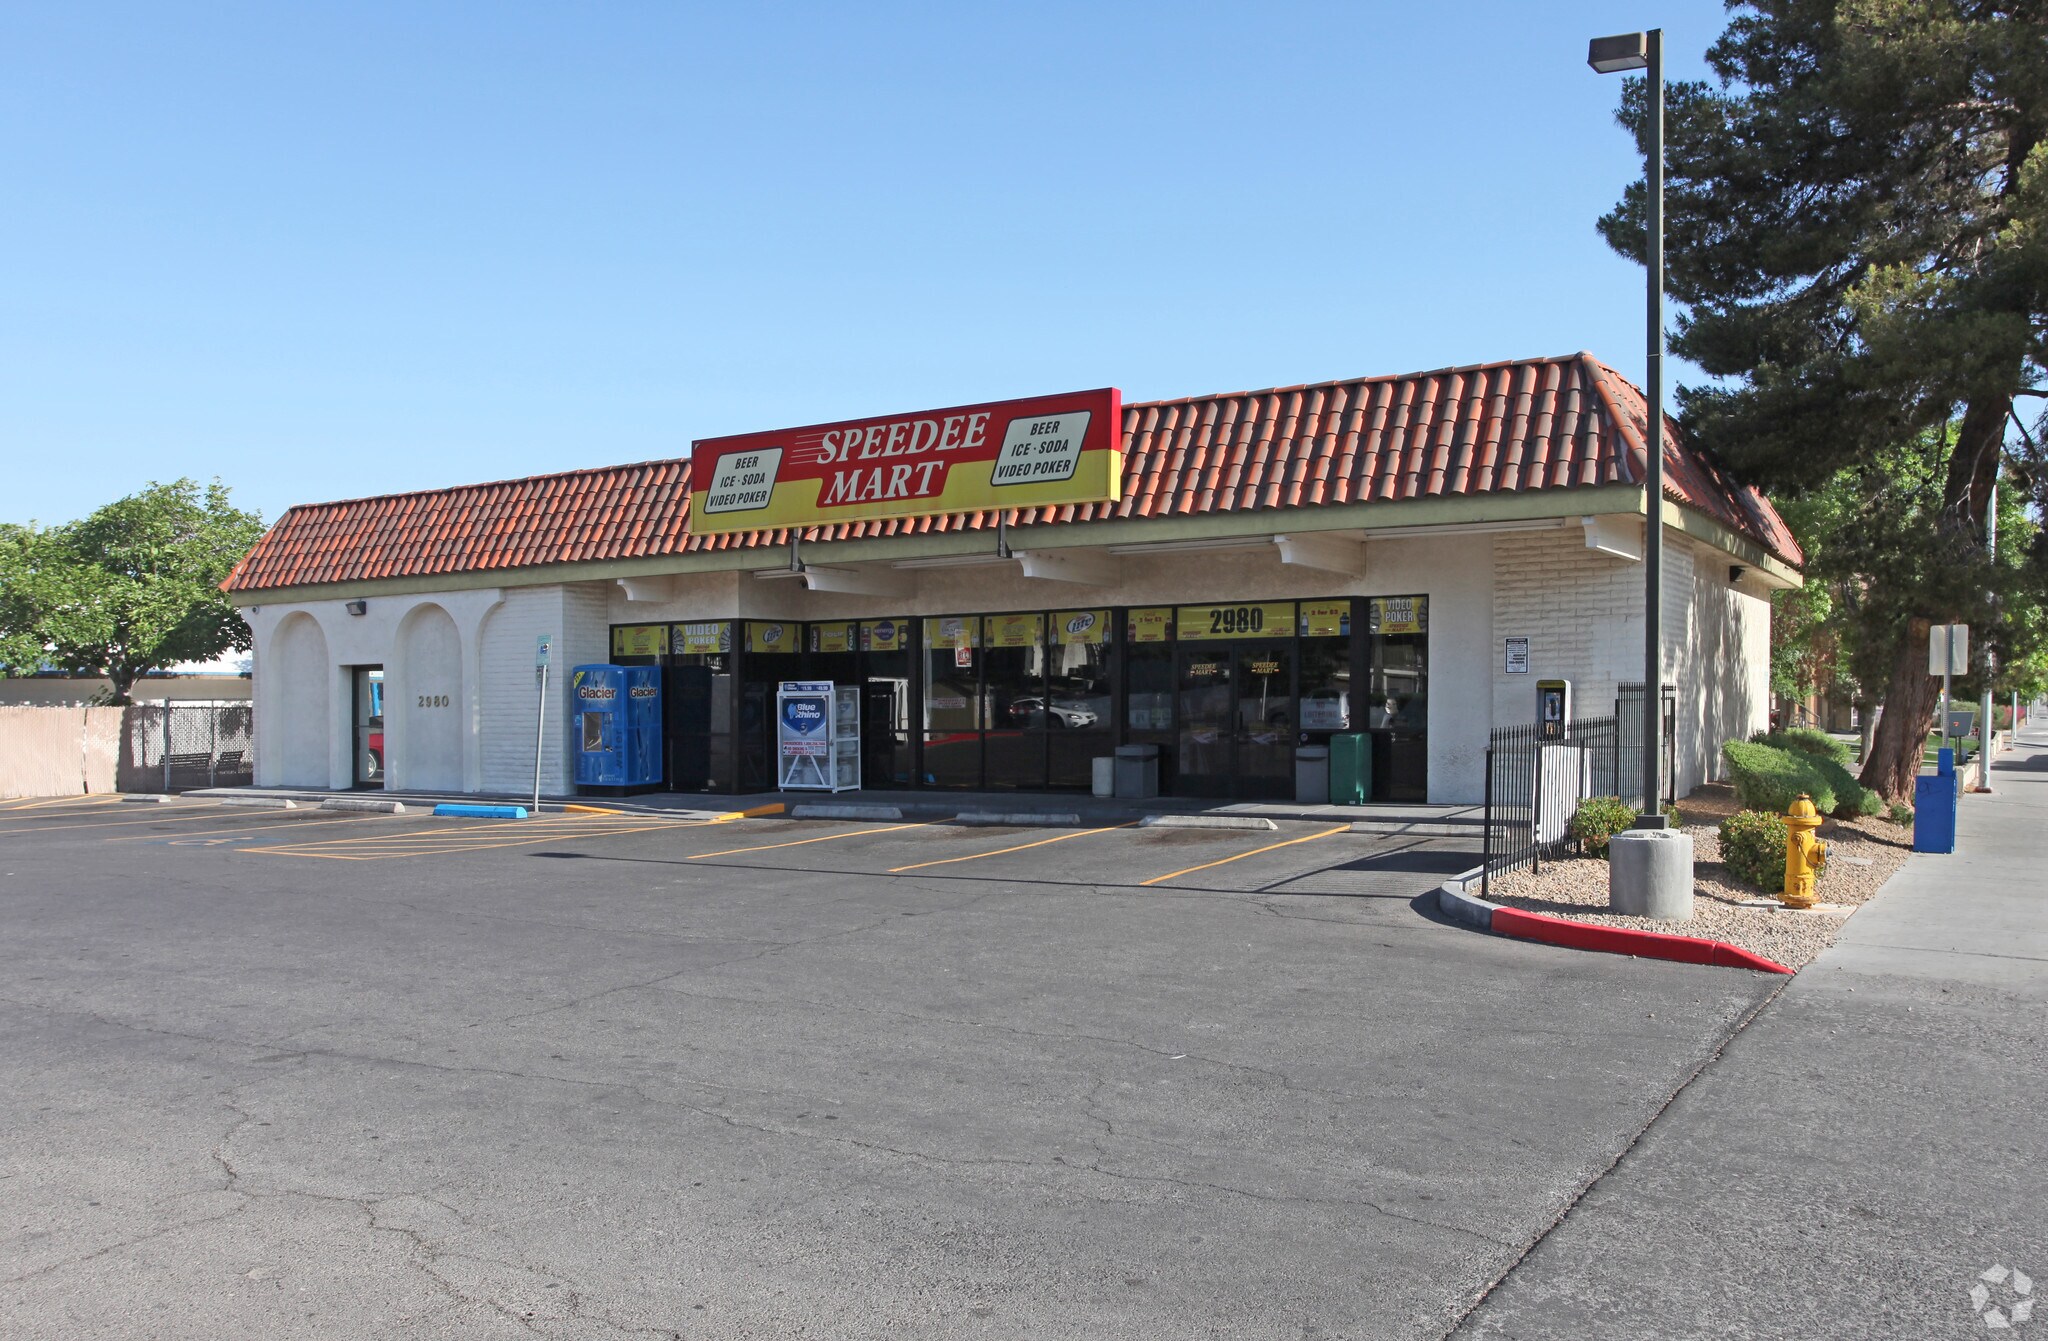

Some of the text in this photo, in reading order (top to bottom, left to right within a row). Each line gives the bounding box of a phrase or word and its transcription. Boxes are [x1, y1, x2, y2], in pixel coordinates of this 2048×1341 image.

[1030, 420, 1060, 436] BEER
[816, 412, 991, 464] SPEEDEE
[1011, 439, 1069, 457] ICE SODA
[735, 456, 759, 469] BEER
[998, 459, 1071, 478] VIDEO POKER
[720, 473, 766, 488] ICE SODA
[824, 460, 944, 504] MART
[710, 490, 768, 507] VIDEO POKER
[1386, 599, 1412, 610] VIDEO
[1209, 607, 1263, 634] 2980
[1385, 611, 1413, 622] POKER
[684, 623, 719, 636] VIDEO
[688, 636, 716, 645] POKER
[580, 687, 616, 699] Glacier
[631, 687, 657, 698] Glacier
[418, 695, 449, 708] 2980
[797, 703, 816, 711] Blue
